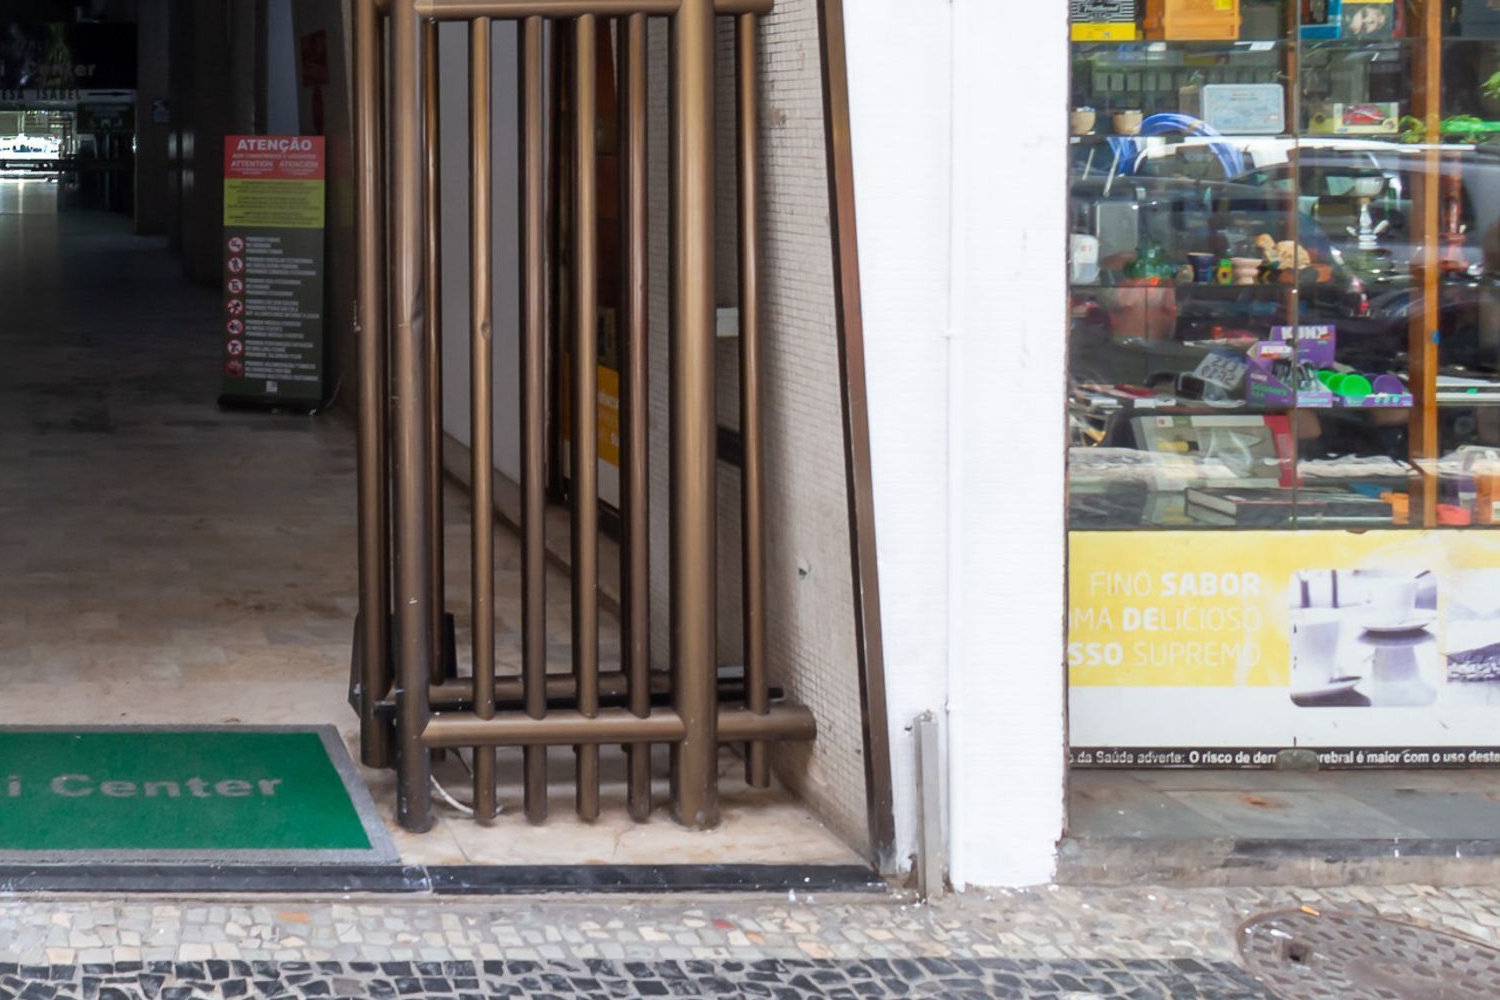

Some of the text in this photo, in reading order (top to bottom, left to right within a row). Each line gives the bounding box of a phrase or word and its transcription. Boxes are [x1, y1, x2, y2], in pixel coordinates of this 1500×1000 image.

[23, 60, 97, 78] Center
[236, 136, 313, 154] ATENÇÃO
[1160, 571, 1261, 597] SABOR
[1122, 606, 1262, 633] DELICIOSO
[1133, 641, 1261, 667] SUPREMO
[1077, 751, 1092, 764] da
[1096, 749, 1134, 764] Saúde
[1137, 750, 1186, 764] adverte:
[1189, 750, 1199, 764] O
[1202, 750, 1232, 763] risco
[1235, 750, 1250, 764] de
[1356, 750, 1364, 764] é
[1366, 750, 1400, 763] maior
[1402, 753, 1430, 763] com
[1432, 754, 1440, 763] o
[1443, 754, 1466, 763] uso
[51, 773, 283, 798] Center
